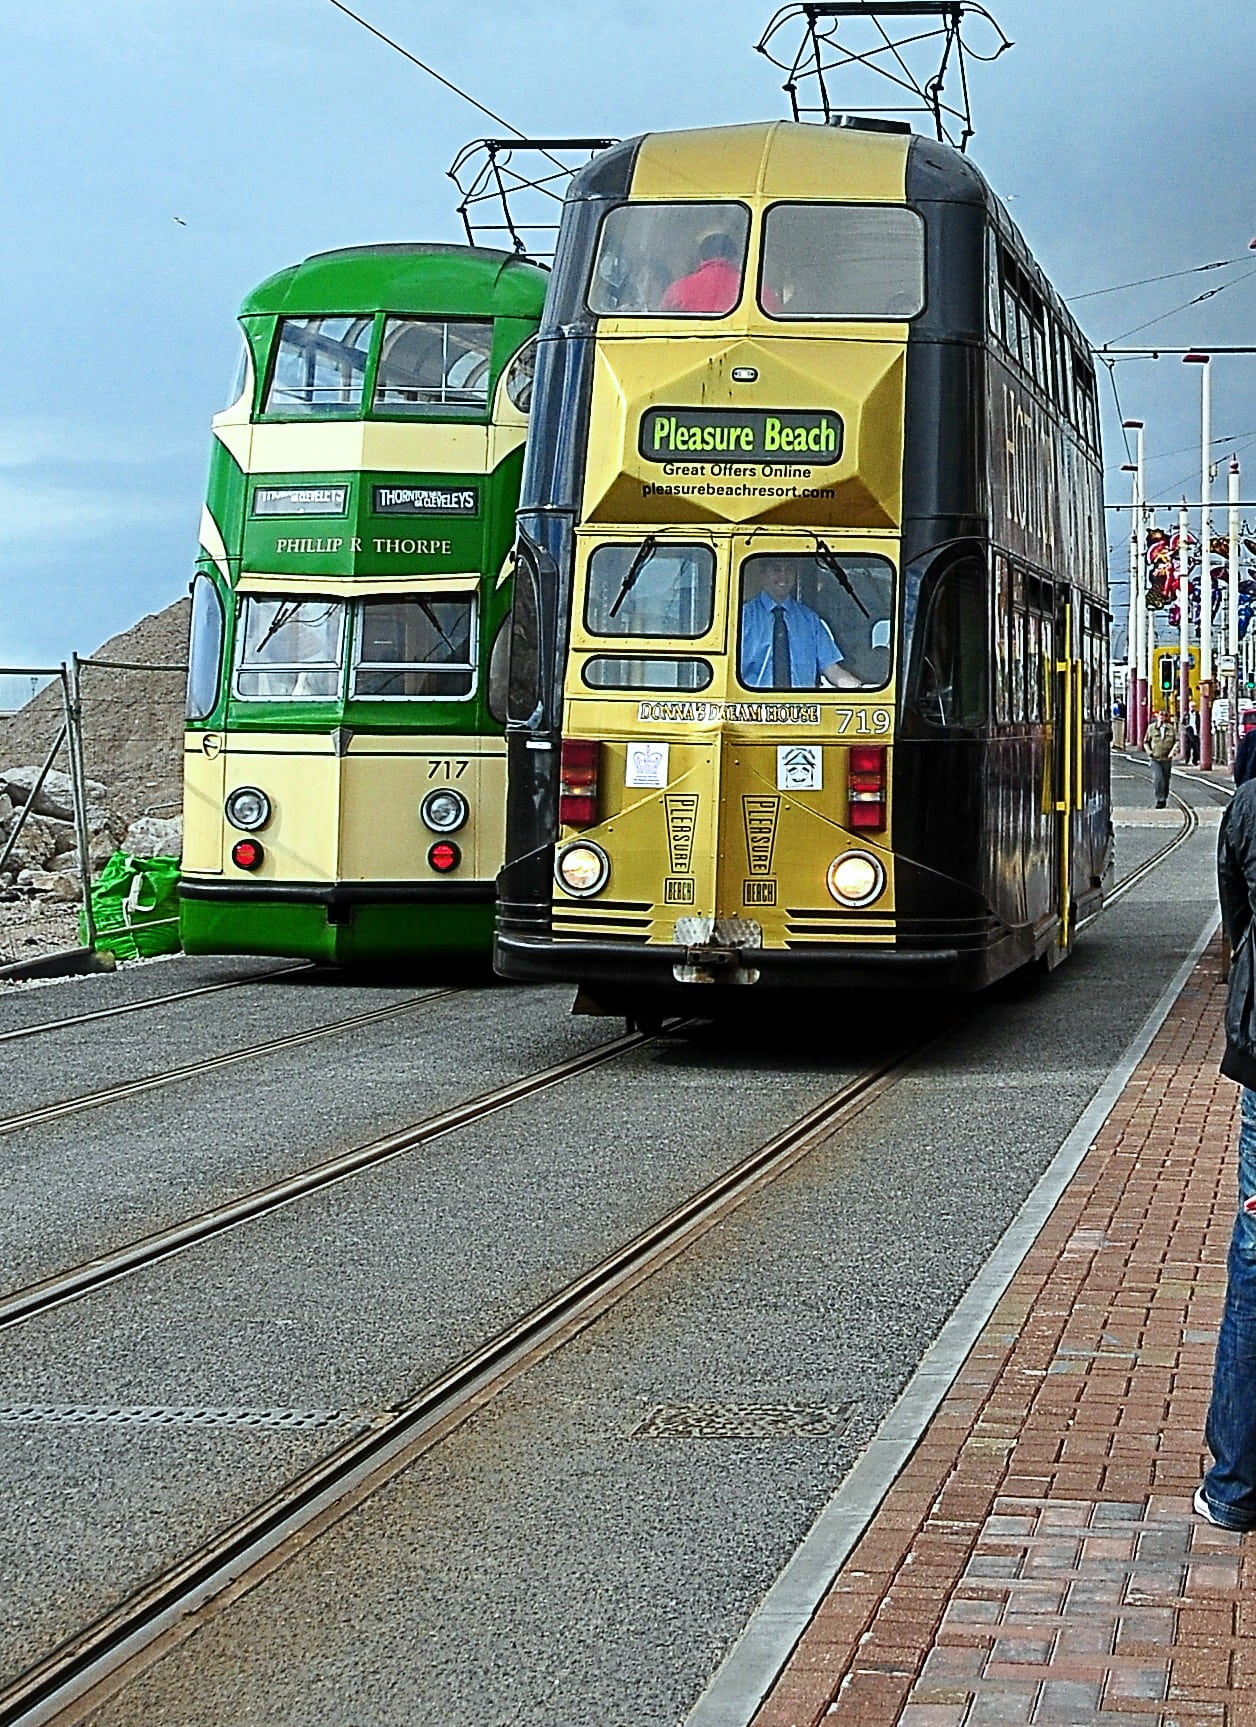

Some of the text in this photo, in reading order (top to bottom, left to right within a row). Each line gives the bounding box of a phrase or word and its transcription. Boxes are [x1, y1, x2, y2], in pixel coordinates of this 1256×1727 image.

[654, 416, 835, 452] Pleasure Beach
[663, 463, 812, 478] Great Offers Online
[642, 483, 835, 499] pleasurebeachresort.com
[276, 537, 452, 554] PHILLIP R THORPE
[640, 702, 706, 721] DONNA'S
[765, 704, 818, 722] HOUSE
[835, 709, 891, 734] 719
[427, 760, 470, 780] 717
[669, 799, 695, 869] PLEASURE
[746, 800, 776, 871] PLEASURE
[746, 883, 773, 903] BEACH
